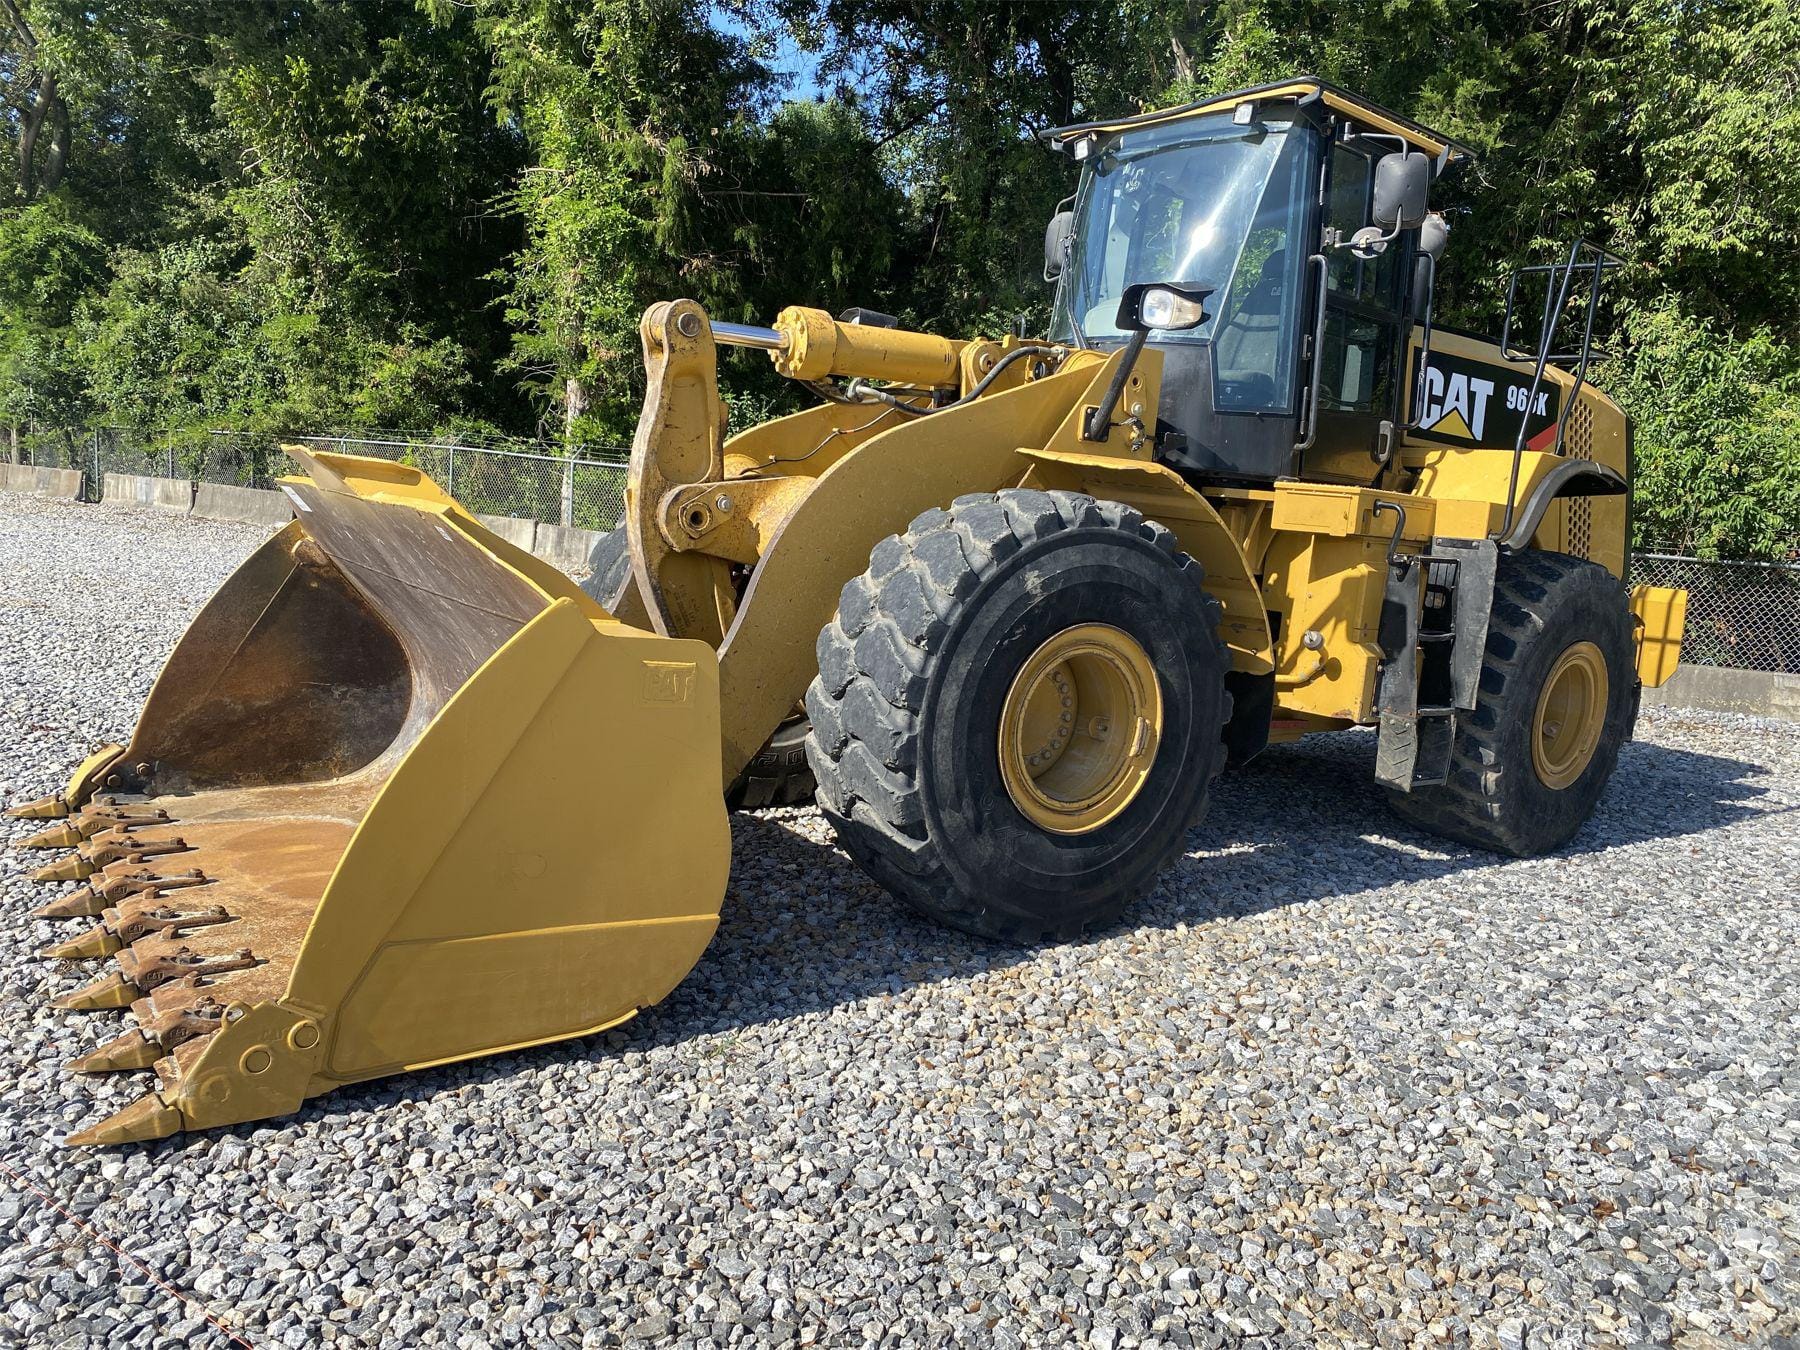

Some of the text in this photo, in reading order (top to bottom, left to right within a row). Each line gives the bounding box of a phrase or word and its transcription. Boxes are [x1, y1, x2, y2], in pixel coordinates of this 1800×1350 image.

[1418, 366, 1549, 441] CAT 96K
[643, 667, 696, 702] CAT
[113, 886, 128, 895] CAT
[128, 924, 145, 933] CAT
[146, 971, 164, 981] CAT
